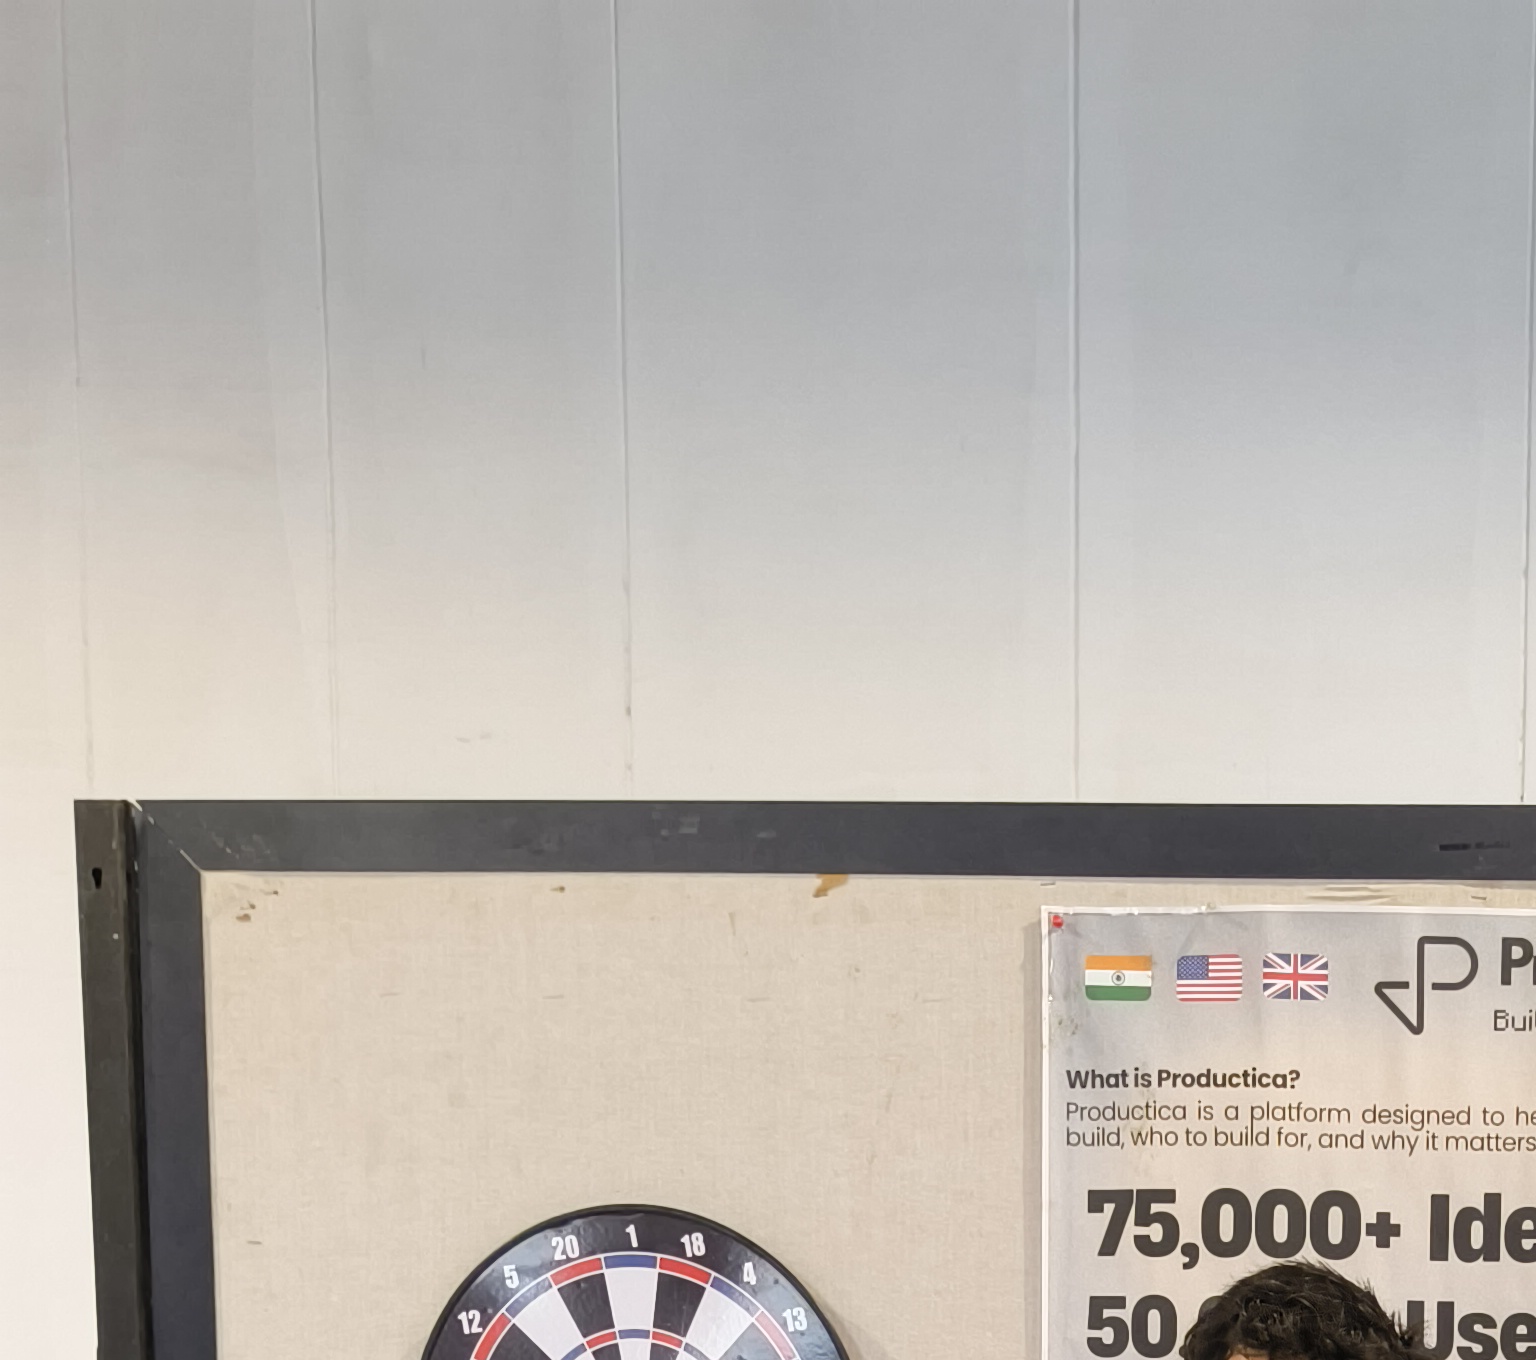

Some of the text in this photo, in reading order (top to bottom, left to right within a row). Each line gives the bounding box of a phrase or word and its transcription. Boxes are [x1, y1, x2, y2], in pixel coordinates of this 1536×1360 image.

[1066, 1067, 1301, 1090] What is Productica?
[1066, 1101, 1187, 1122] Productica
[1198, 1102, 1214, 1122] is
[1224, 1107, 1239, 1122] a
[1251, 1103, 1351, 1131] platform
[1361, 1104, 1471, 1131] designed
[1482, 1108, 1505, 1127] to
[1066, 1127, 1125, 1151] build,
[1131, 1127, 1178, 1147] who
[1184, 1129, 1207, 1147] to
[1214, 1126, 1270, 1148] build
[1276, 1127, 1312, 1152] for,
[1318, 1128, 1365, 1150] and
[1371, 1130, 1420, 1156] why
[1425, 1131, 1438, 1151] it
[625, 1224, 639, 1249] 1
[1087, 1188, 1401, 1270] 75,000+
[551, 1234, 580, 1260] 20
[680, 1232, 706, 1258] 18
[503, 1265, 520, 1289] 5
[742, 1260, 757, 1286] 4
[457, 1309, 484, 1335] 12
[782, 1306, 808, 1331] 13
